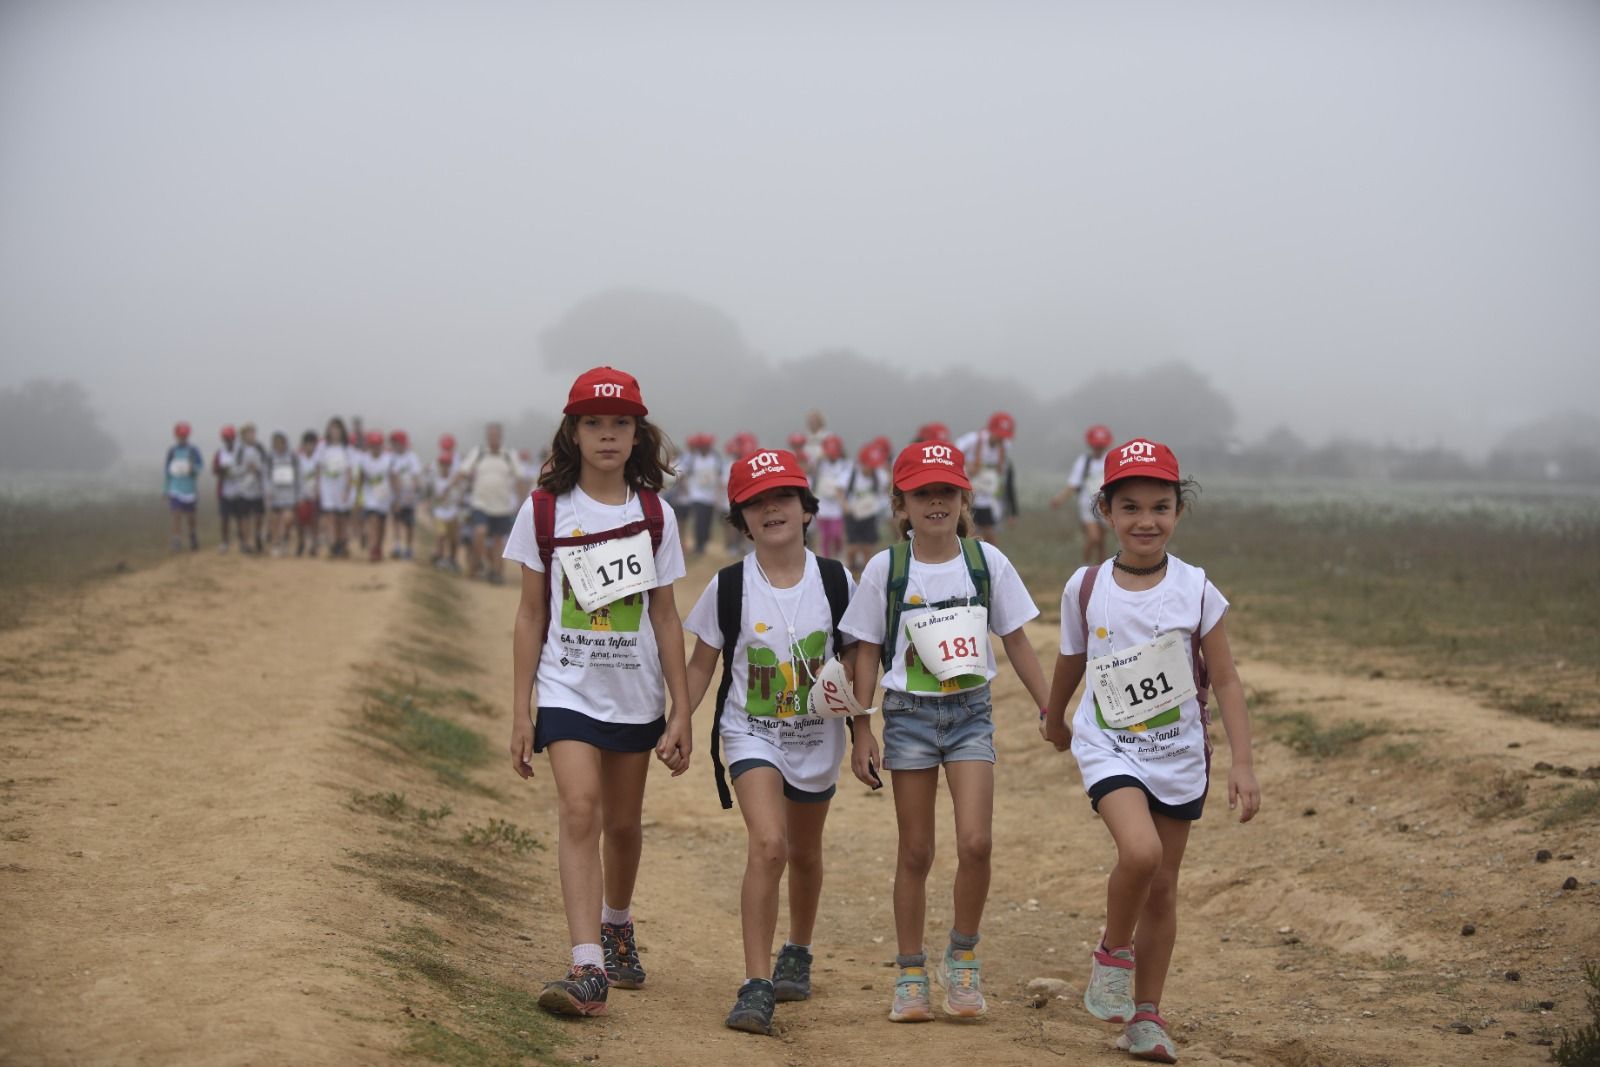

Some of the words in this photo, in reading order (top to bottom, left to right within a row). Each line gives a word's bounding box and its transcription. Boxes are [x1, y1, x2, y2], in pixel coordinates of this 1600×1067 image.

[593, 383, 624, 398] TOT
[922, 445, 952, 459] TOT
[1120, 441, 1155, 458] TOT
[747, 452, 779, 471] TOT
[1119, 456, 1133, 466] Sant
[751, 468, 766, 479] Sant
[596, 554, 641, 587] 176
[938, 636, 979, 662] 181
[822, 679, 850, 713] 176
[1125, 671, 1174, 706] 181
